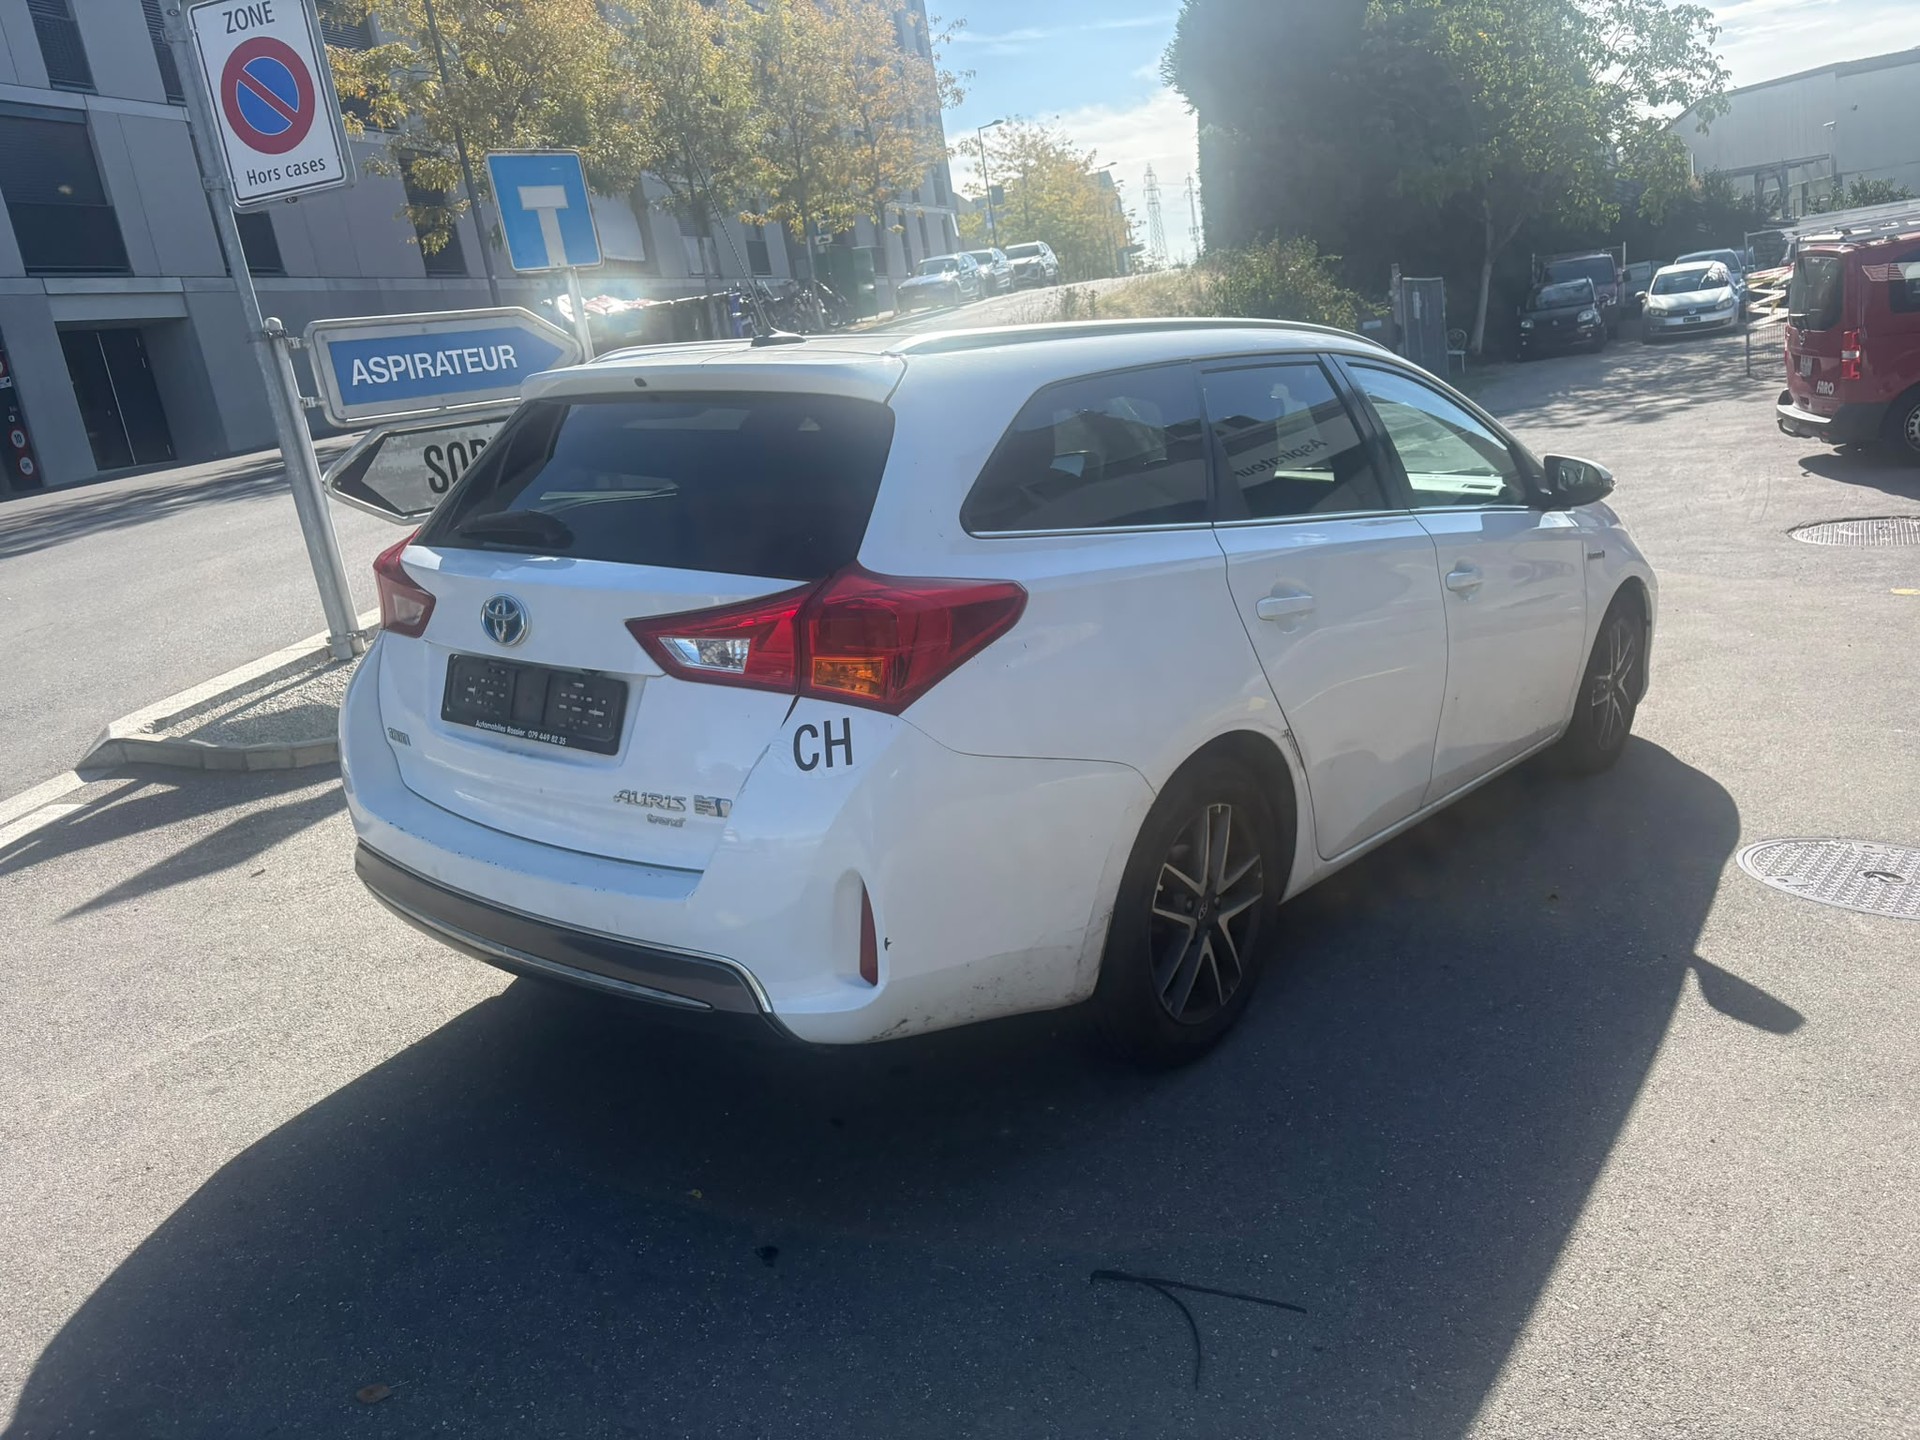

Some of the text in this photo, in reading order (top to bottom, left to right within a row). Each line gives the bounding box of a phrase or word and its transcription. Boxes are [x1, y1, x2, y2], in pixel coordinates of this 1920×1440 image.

[222, 1, 275, 34] ZONE
[246, 158, 326, 187] Hors cases
[352, 344, 518, 386] ASPIRATEUR
[475, 720, 505, 732] Automobiles
[528, 730, 538, 739] 079
[539, 732, 550, 742] 449
[551, 734, 559, 744] 82
[559, 737, 566, 745] 35
[793, 717, 853, 772] CH
[613, 789, 687, 812] AURIS
